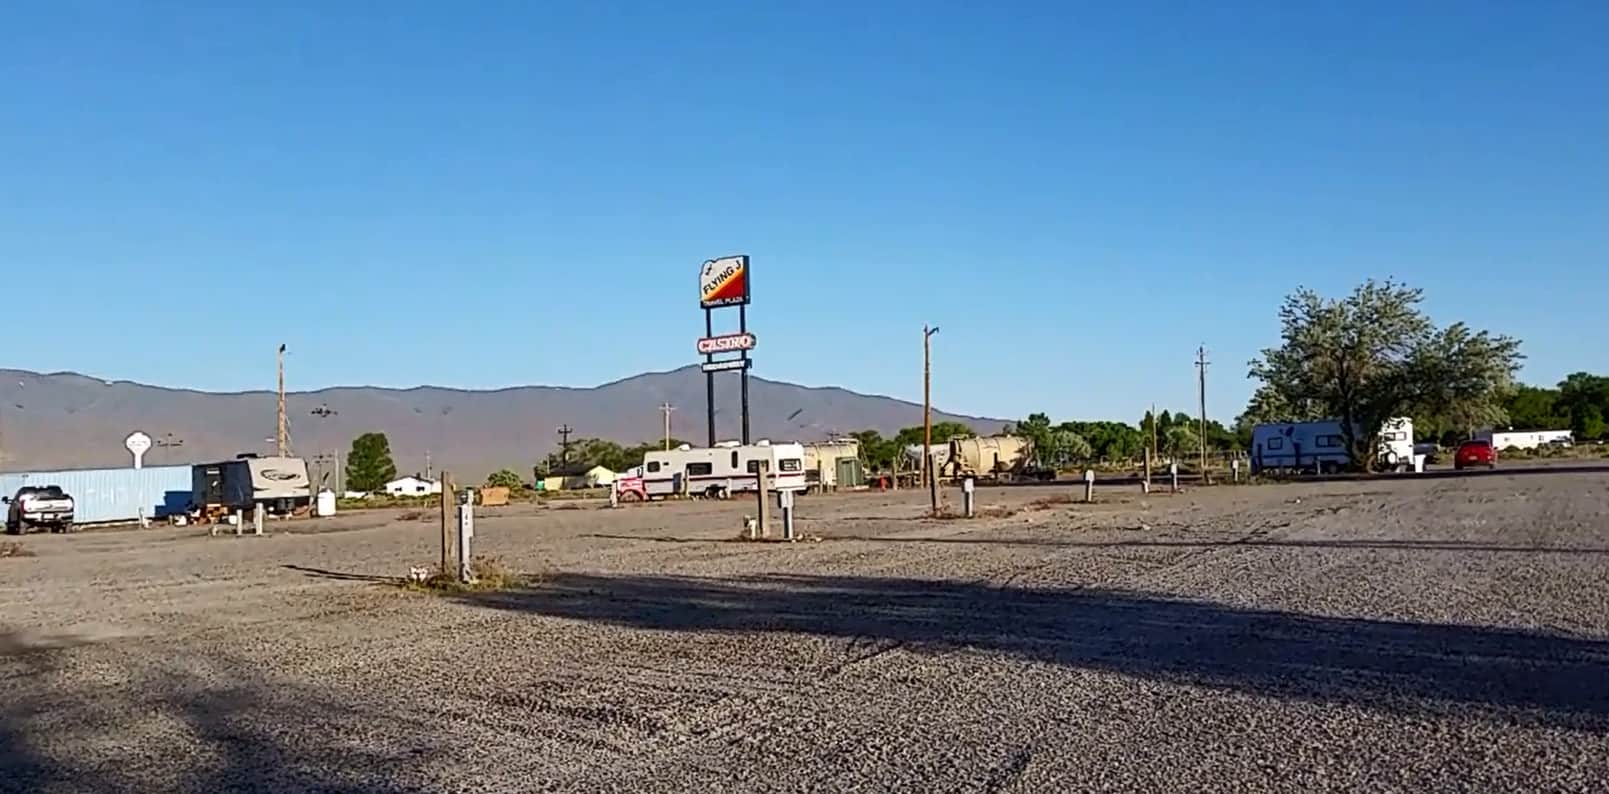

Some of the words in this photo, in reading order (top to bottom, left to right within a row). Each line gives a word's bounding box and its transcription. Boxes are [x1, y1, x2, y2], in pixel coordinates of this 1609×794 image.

[703, 266, 734, 295] FLYING
[735, 260, 742, 270] J
[698, 335, 751, 353] CASINO
